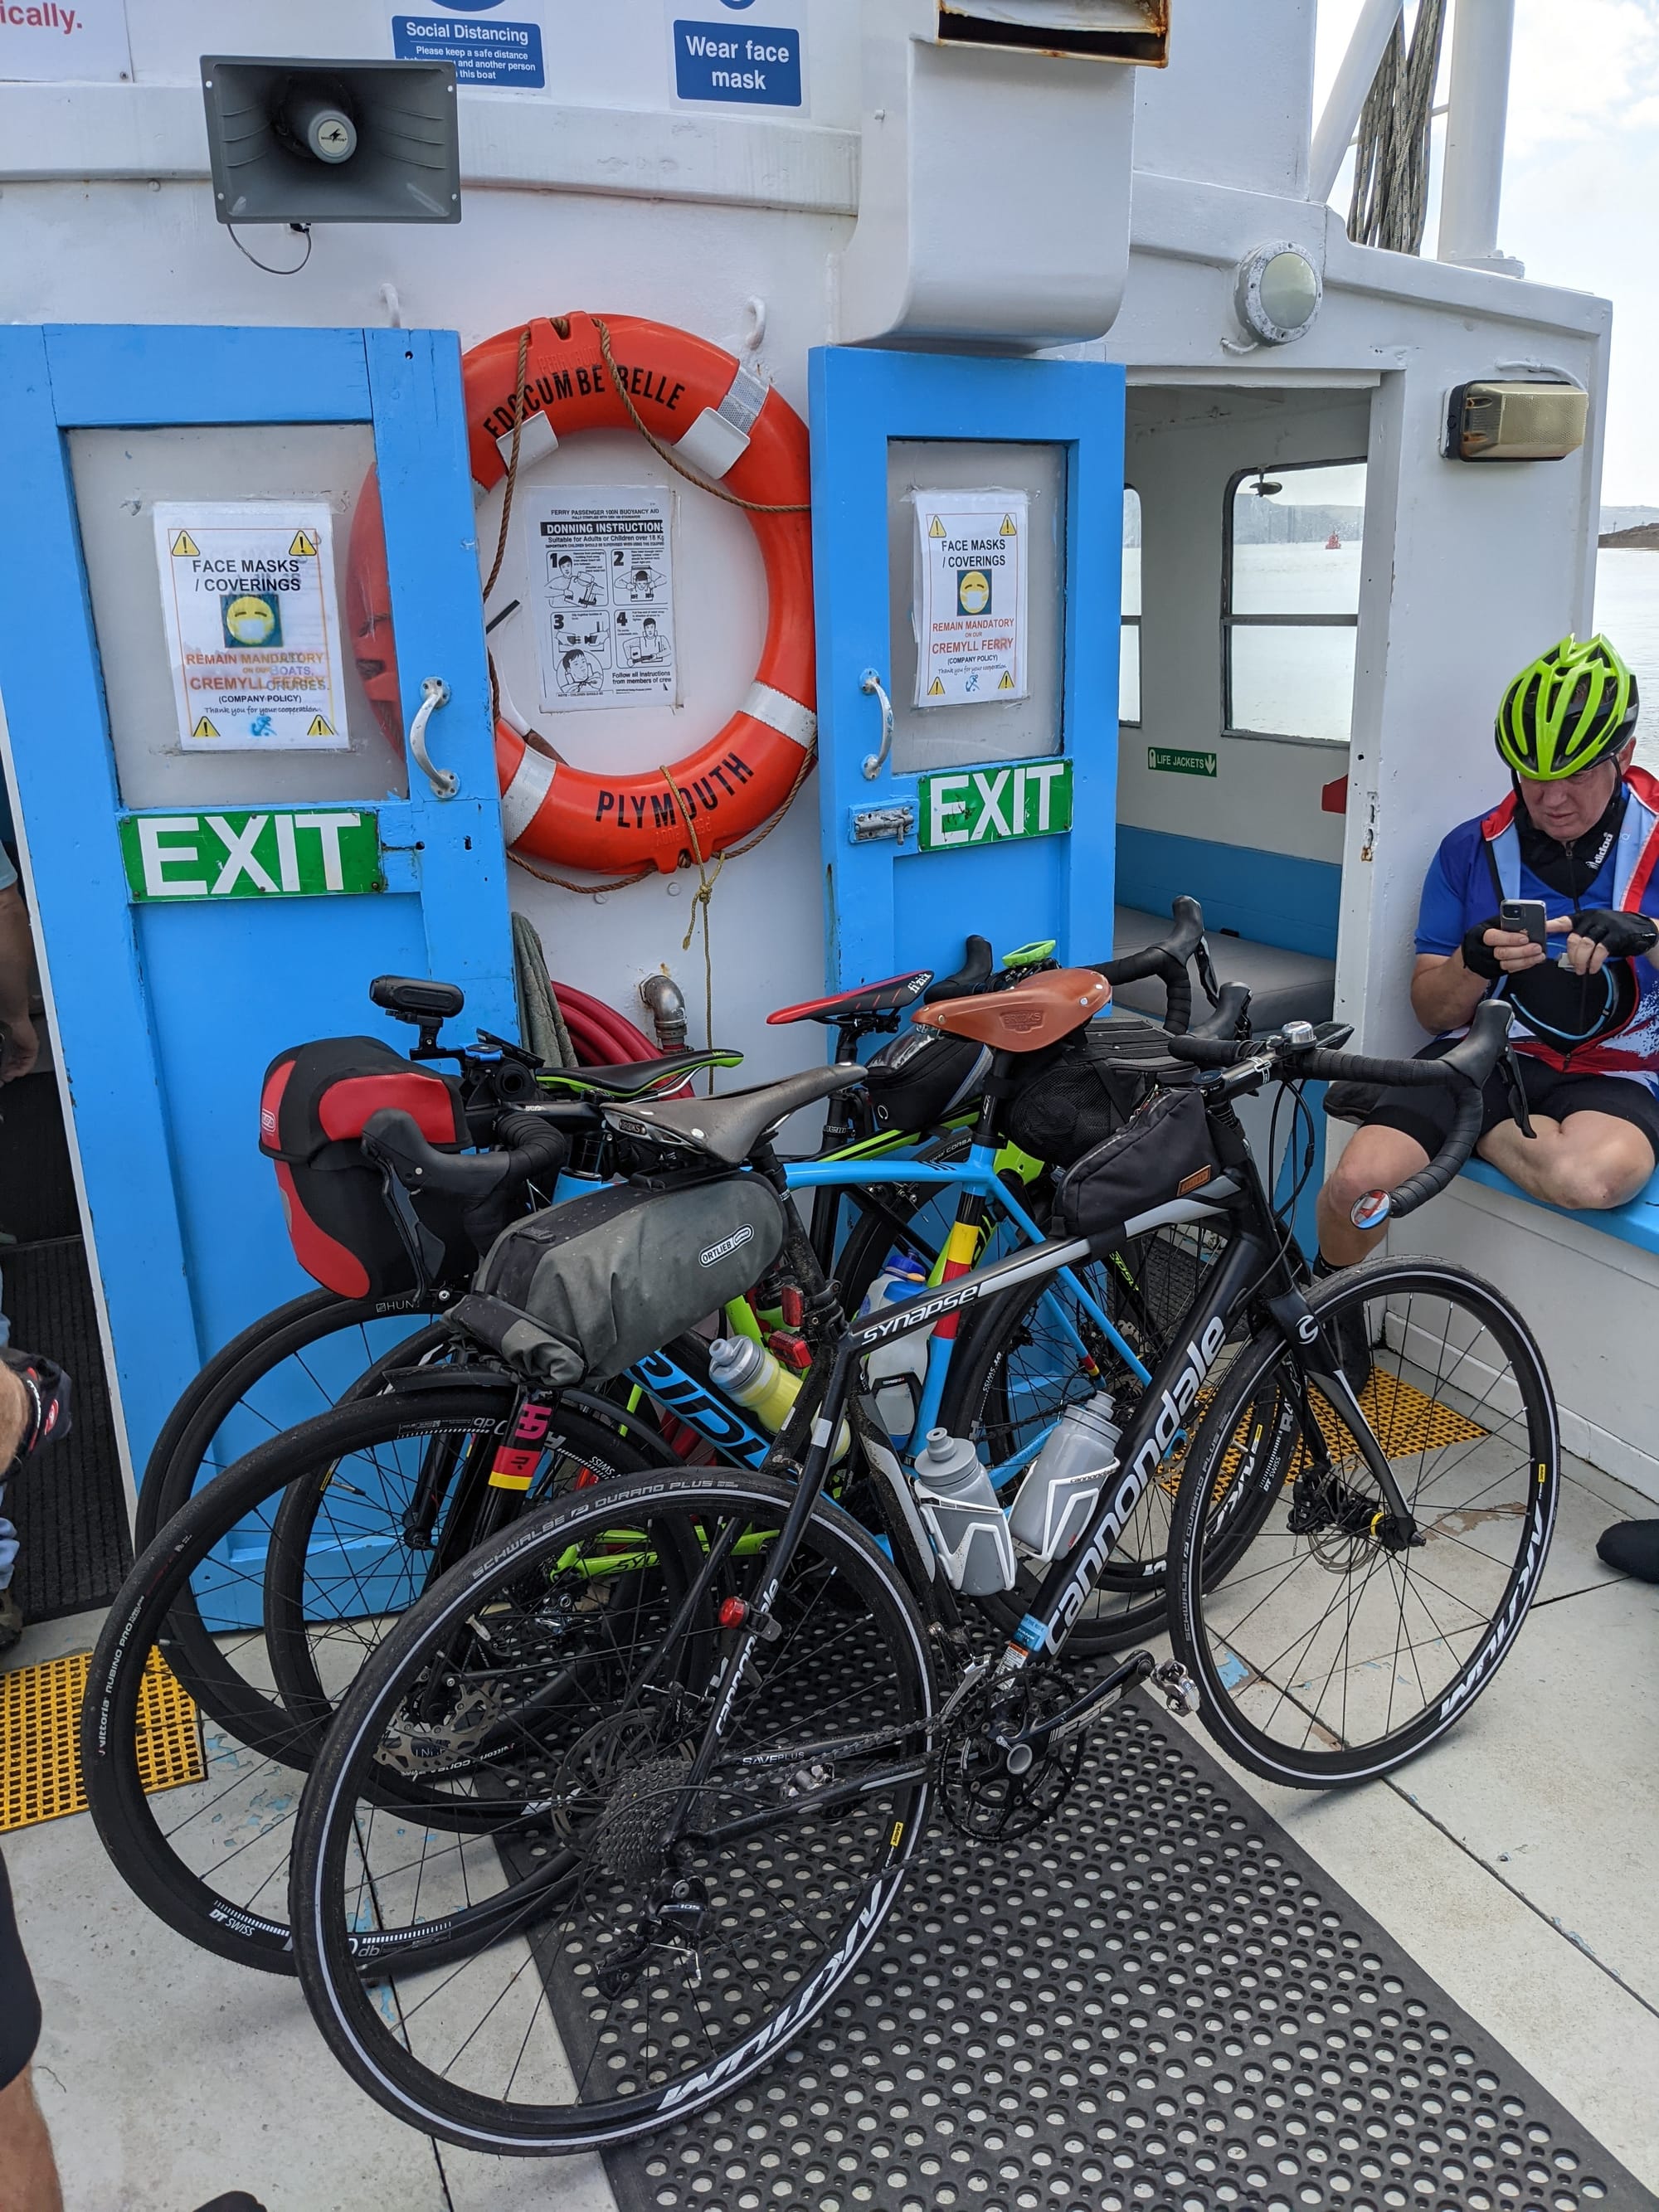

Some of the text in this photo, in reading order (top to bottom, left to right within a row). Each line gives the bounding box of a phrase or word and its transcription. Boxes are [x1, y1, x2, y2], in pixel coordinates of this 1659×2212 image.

[0, 0, 83, 35] ically.
[406, 22, 528, 46] Social Distancing
[416, 46, 444, 56] Please
[445, 48, 465, 58] keep
[474, 49, 493, 58] safe
[494, 51, 528, 60] distance
[685, 35, 789, 63] Wear face
[475, 61, 506, 70] another
[508, 62, 535, 71] person
[460, 70, 496, 80] this boat
[712, 70, 766, 90] mask
[616, 364, 686, 411] BELLE
[547, 523, 593, 534] DONNING
[941, 539, 1006, 552] FACE MASKS
[192, 559, 299, 573] FACE MASKS
[550, 552, 557, 568] 1
[614, 551, 624, 566] 2
[948, 555, 1006, 567] COVERINGS
[204, 577, 301, 592] COVERINGS
[554, 615, 564, 630] 3
[616, 612, 627, 626] 4
[933, 618, 1014, 632] REMAIN MANDATORY
[932, 638, 1014, 654] CREMYLL FERRY
[186, 654, 237, 664] REMAIN
[948, 656, 975, 665] (COMPANY
[189, 677, 267, 690] CREMYLL
[219, 695, 301, 704] (COMPANY POLICY)
[231, 707, 245, 717] you
[246, 707, 258, 716] for
[259, 707, 278, 717] your
[1156, 755, 1204, 769] LIFE JACKETS
[595, 751, 755, 829] PLYMOUTH
[929, 762, 1064, 848] EXIT
[137, 812, 362, 897] EXIT
[702, 1241, 732, 1262] ORTLIEB
[1262, 1456, 1282, 1493] DT SWISS
[1044, 1315, 1225, 1657] cannondale
[472, 1515, 566, 1580] SCHWALBE
[595, 1484, 664, 1508] DURANO
[669, 1480, 713, 1492] PLUS
[1180, 1432, 1220, 1641] SCHWALBE DURANO PLUS
[99, 1621, 134, 1748] vittoria RUBINO PRO
[209, 1908, 256, 1937] DT SWISS
